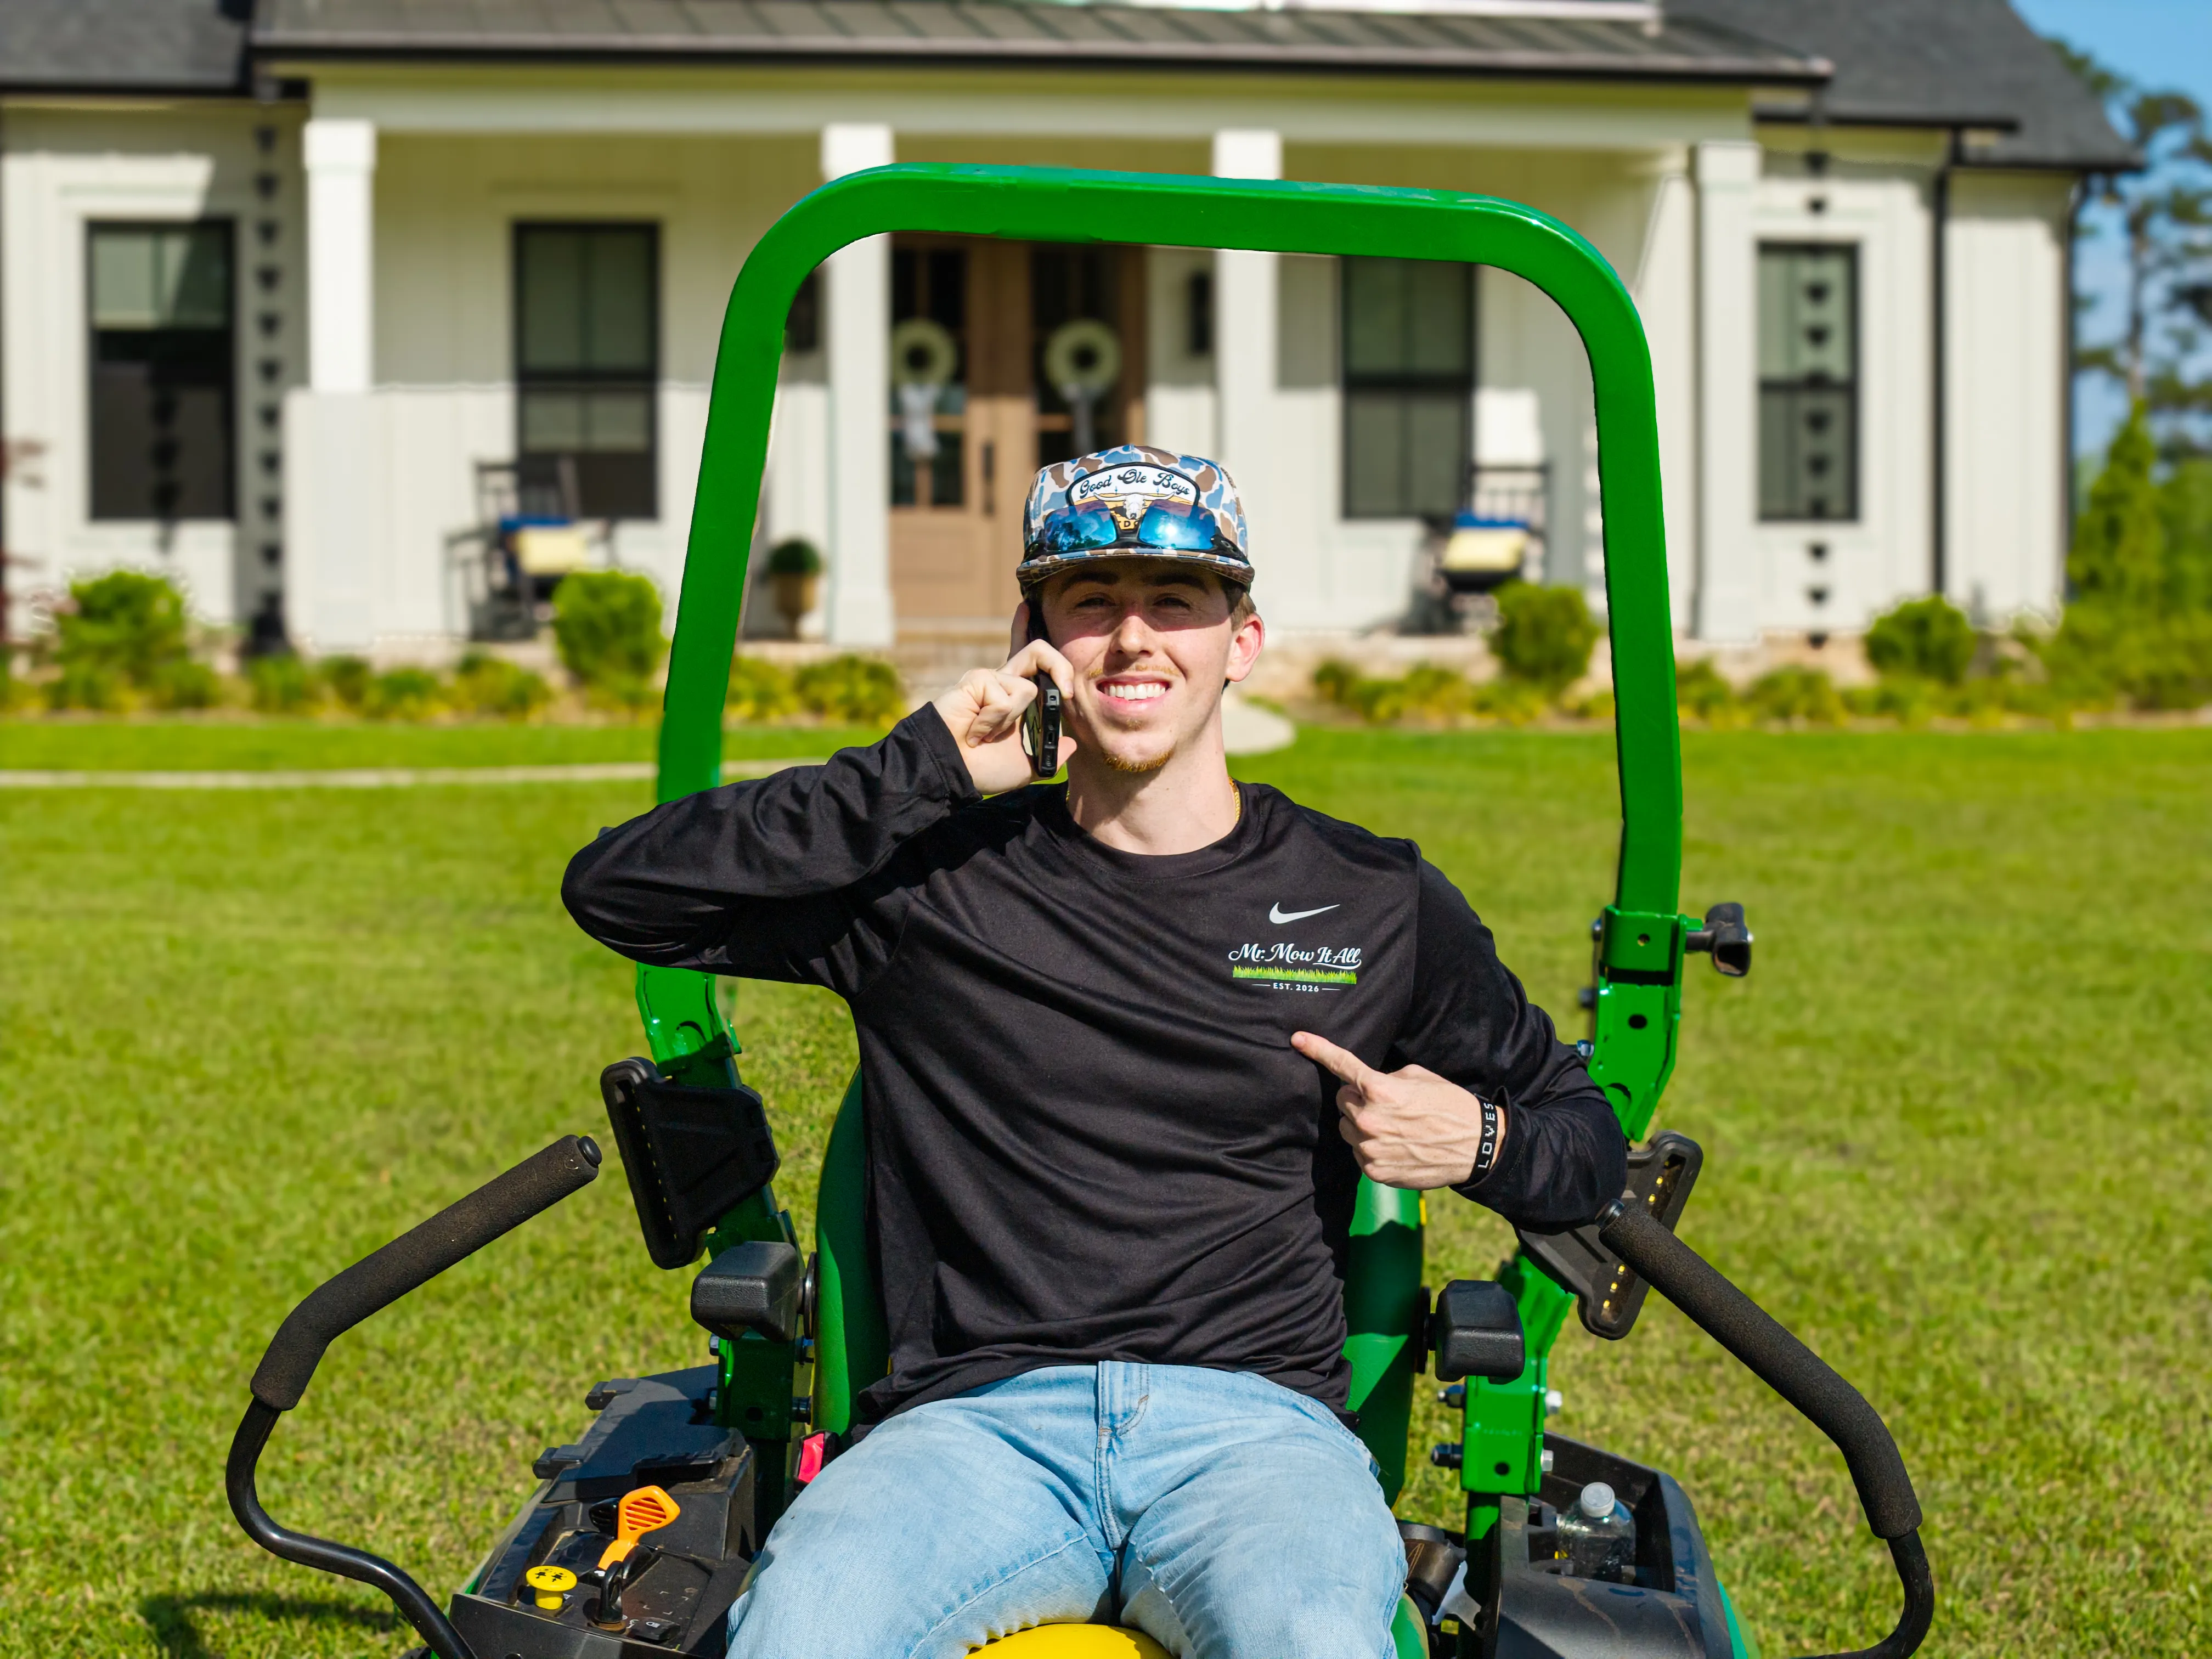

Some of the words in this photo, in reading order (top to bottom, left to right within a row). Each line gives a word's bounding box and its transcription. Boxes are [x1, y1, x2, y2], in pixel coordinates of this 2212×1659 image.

[1079, 475, 1111, 499] Good
[1118, 469, 1147, 484] Ole
[1153, 472, 1190, 495] Boys
[1228, 943, 1265, 962] Mr.
[1265, 943, 1314, 963] Mow
[1317, 947, 1333, 963] It
[1333, 947, 1362, 967] All
[1273, 982, 1293, 991] EST.
[1295, 984, 1319, 992] 2026
[1477, 1102, 1496, 1169] LOVES
